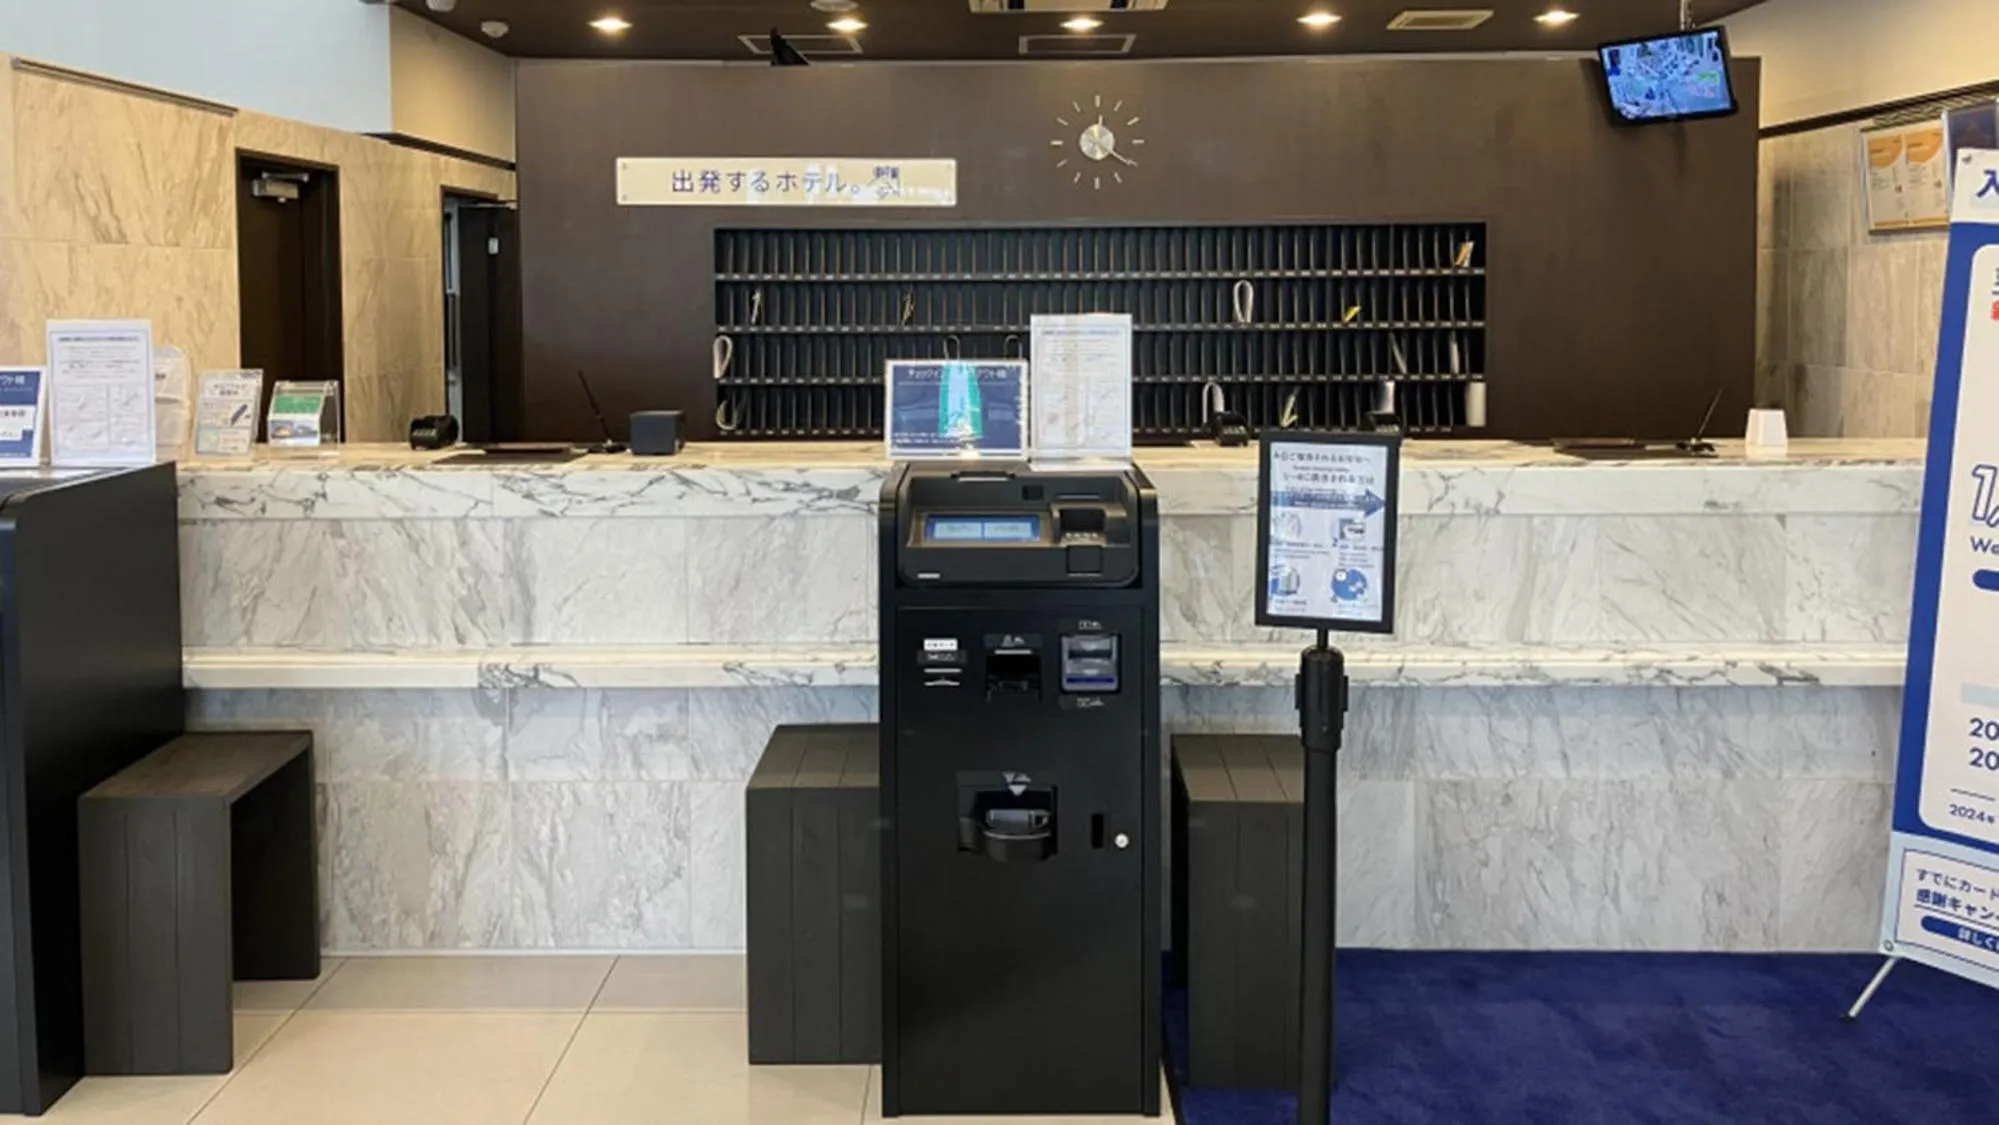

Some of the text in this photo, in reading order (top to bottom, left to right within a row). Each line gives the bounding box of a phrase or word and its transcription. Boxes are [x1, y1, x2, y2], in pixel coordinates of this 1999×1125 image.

[671, 169, 862, 195] 出発するホテル。
[1916, 888, 1999, 920] 感謝キャン
